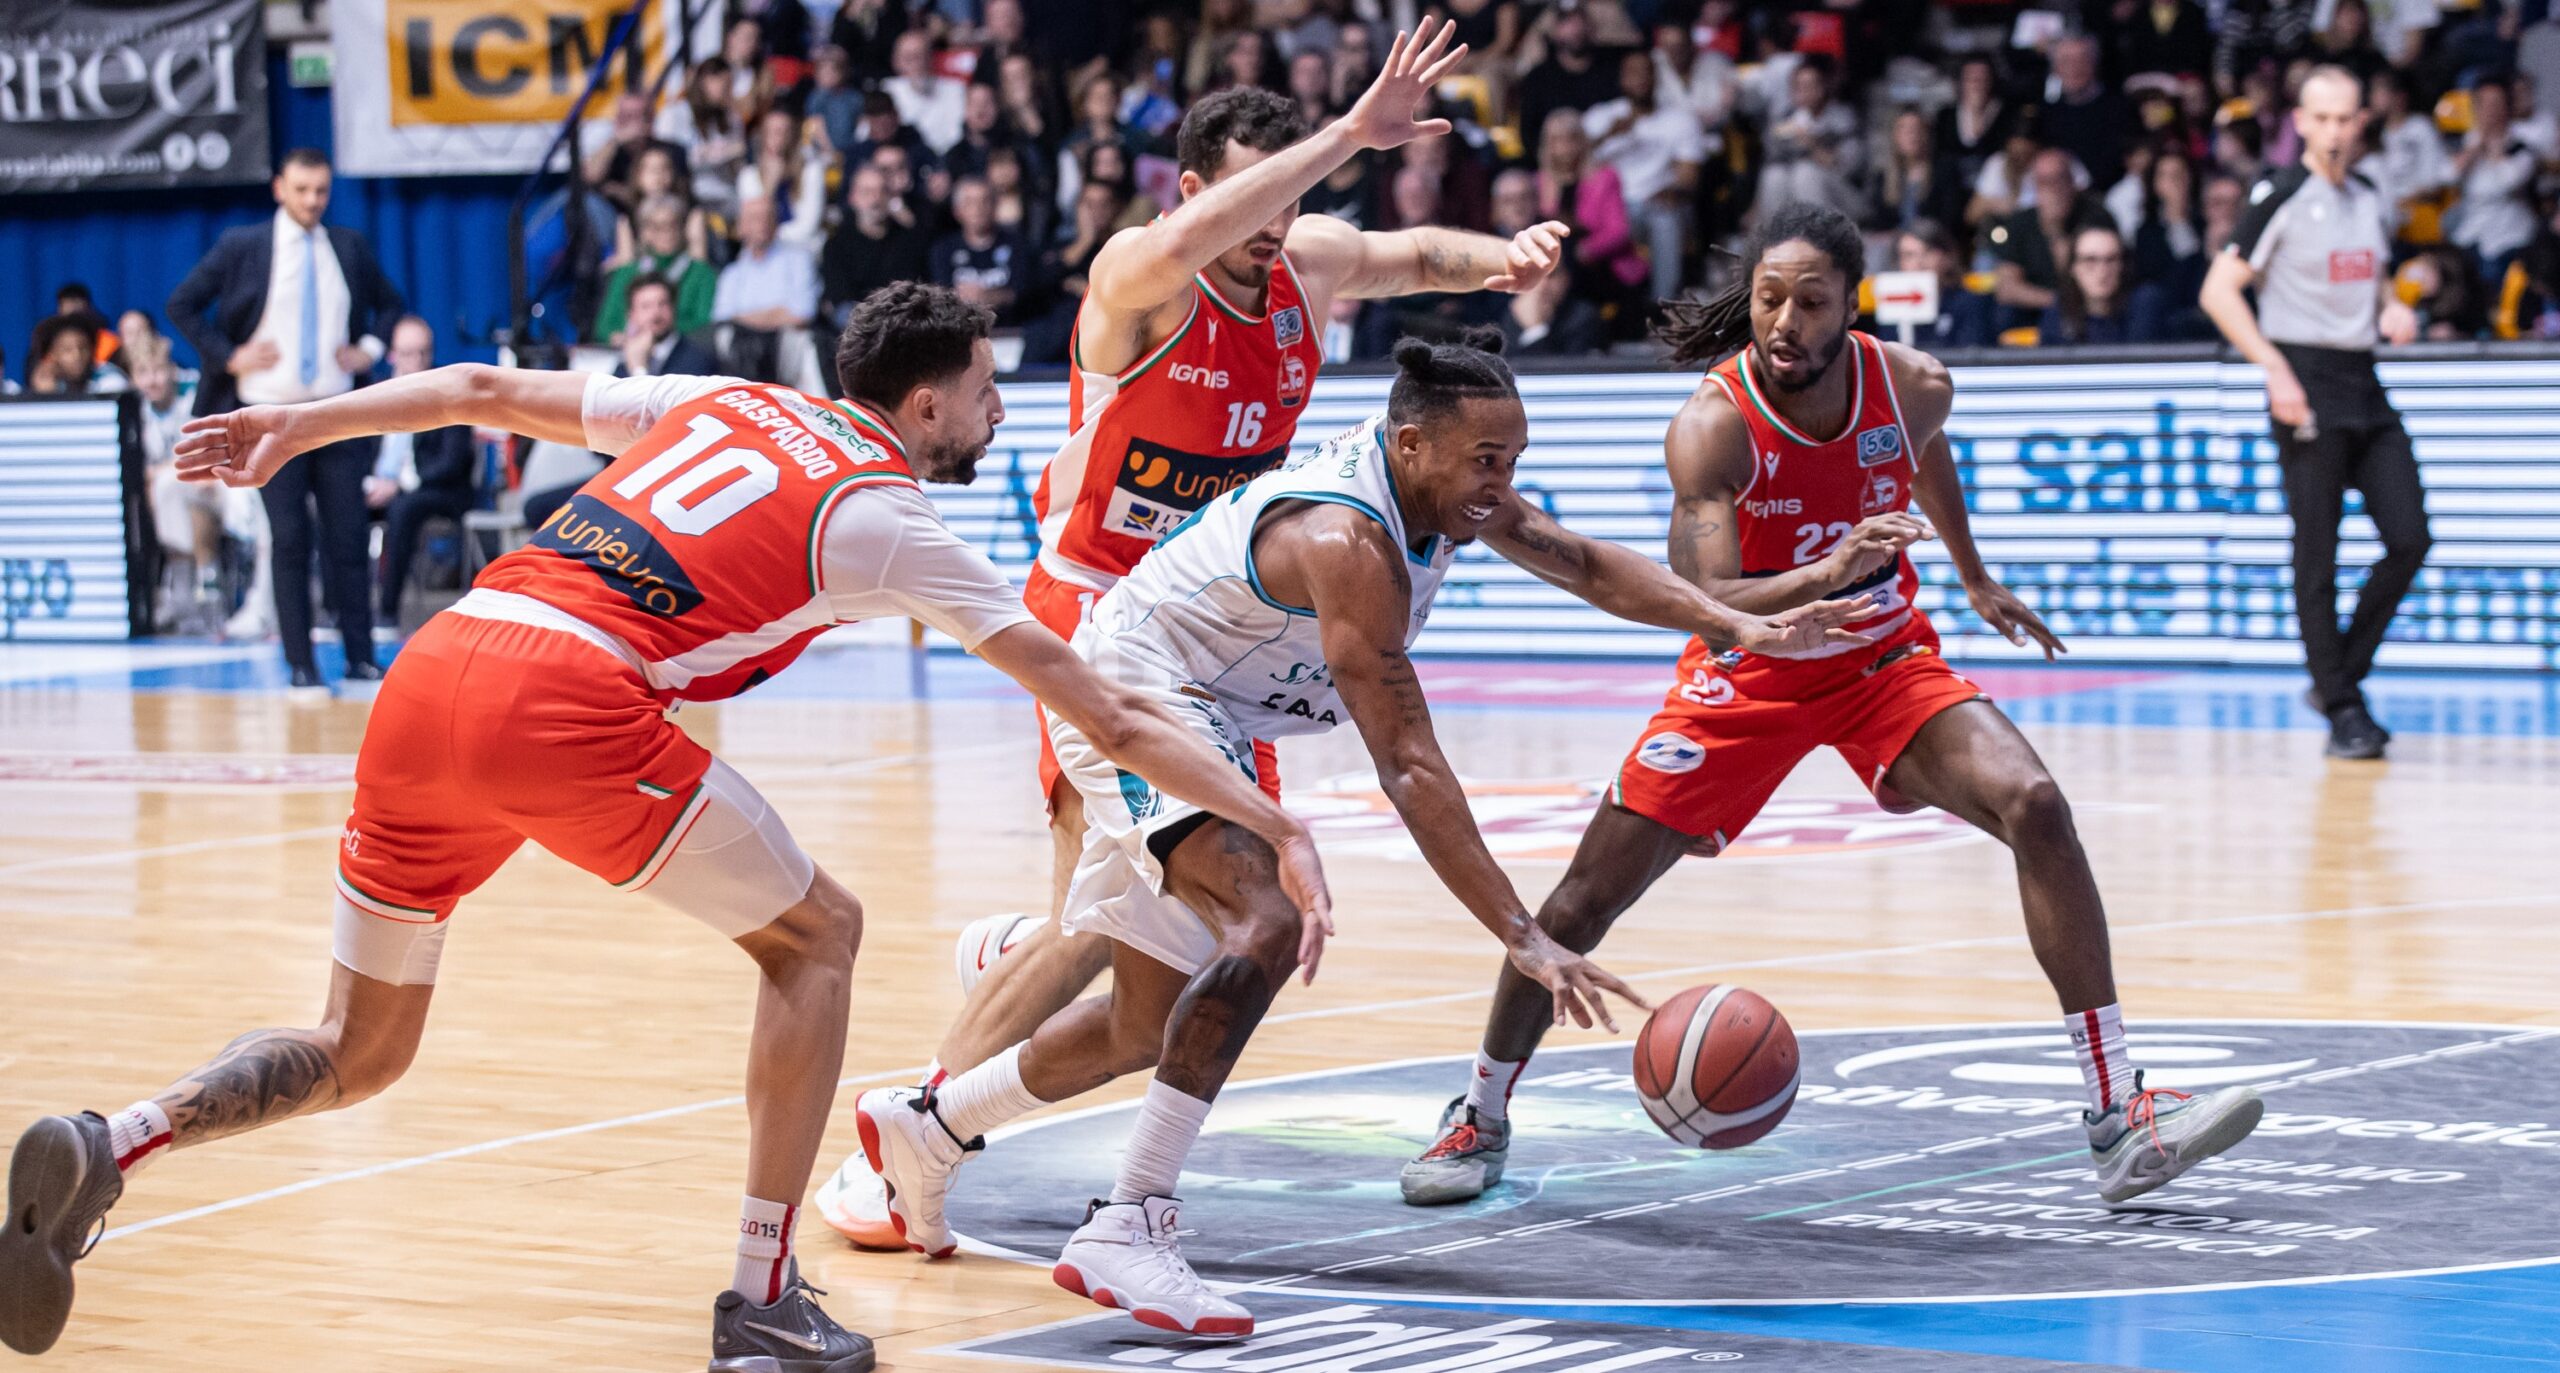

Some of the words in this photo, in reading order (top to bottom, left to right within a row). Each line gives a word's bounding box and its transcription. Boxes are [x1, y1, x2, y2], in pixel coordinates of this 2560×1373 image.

[406, 13, 645, 97] ICM
[715, 390, 838, 480] GASPARDO
[1222, 402, 1267, 449] 16
[612, 412, 780, 536] 10
[556, 512, 678, 615] unieuro
[1793, 521, 1853, 565] 22
[1077, 592, 1095, 624] 1
[1954, 1182, 2074, 1197] LA
[1803, 1213, 2301, 1257] ENERGETICA
[1884, 1197, 2379, 1241] AUTONOMIA
